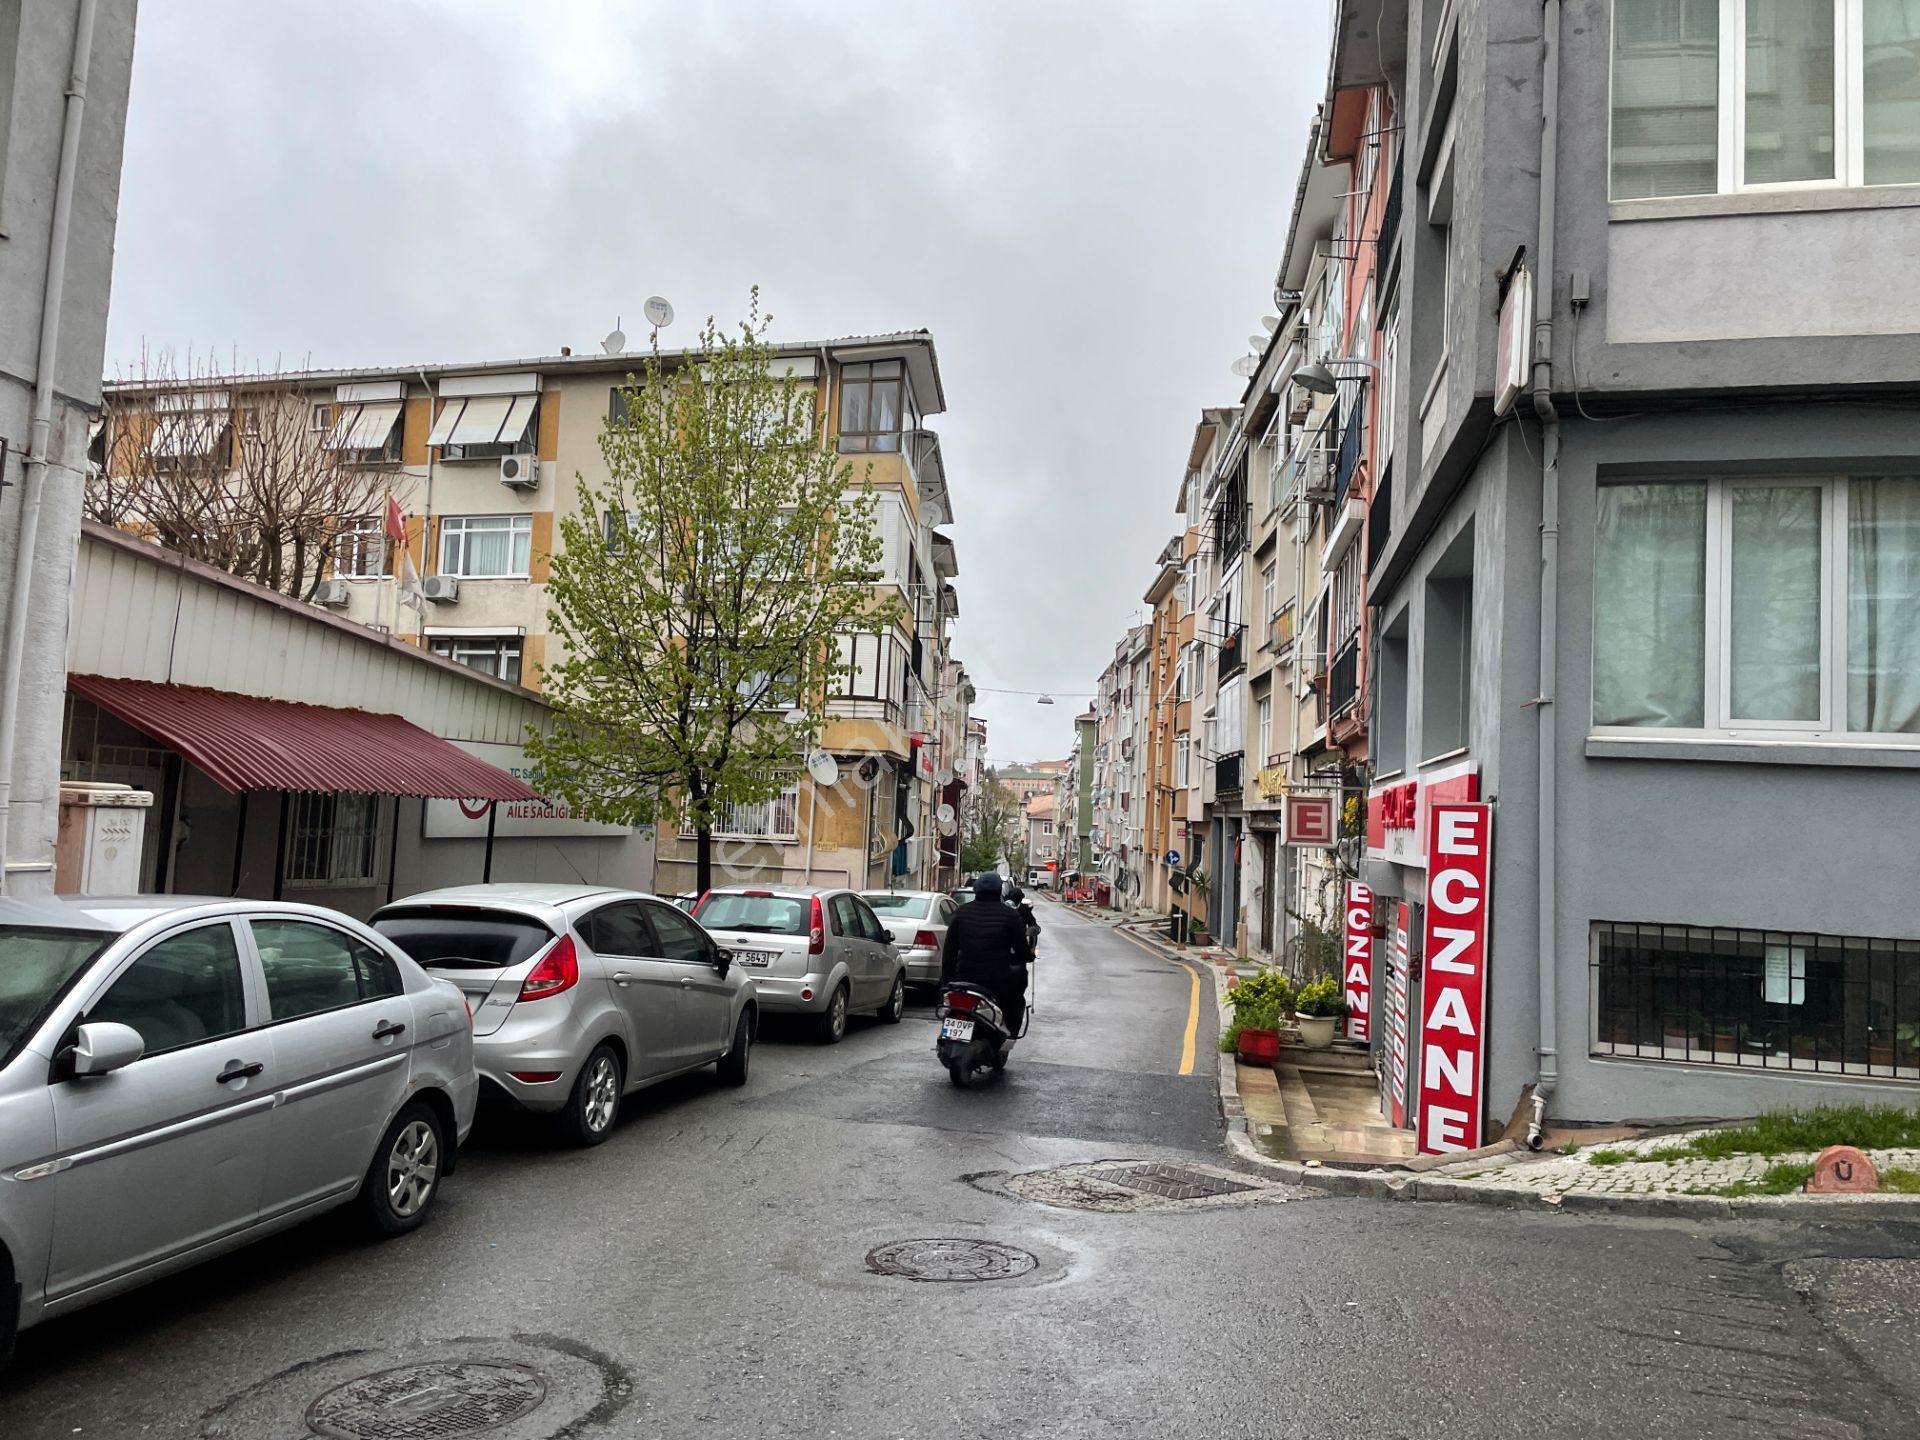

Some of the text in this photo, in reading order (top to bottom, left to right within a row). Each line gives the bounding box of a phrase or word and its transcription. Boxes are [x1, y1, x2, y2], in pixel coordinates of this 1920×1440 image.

[506, 803, 529, 819] AİLE
[1296, 805, 1323, 836] E
[745, 952, 767, 963] 5643
[1346, 881, 1371, 1041] ECZANE
[1425, 809, 1480, 1155] ECZANE
[945, 1019, 974, 1030] 34 DVP
[949, 1028, 964, 1038] 197
